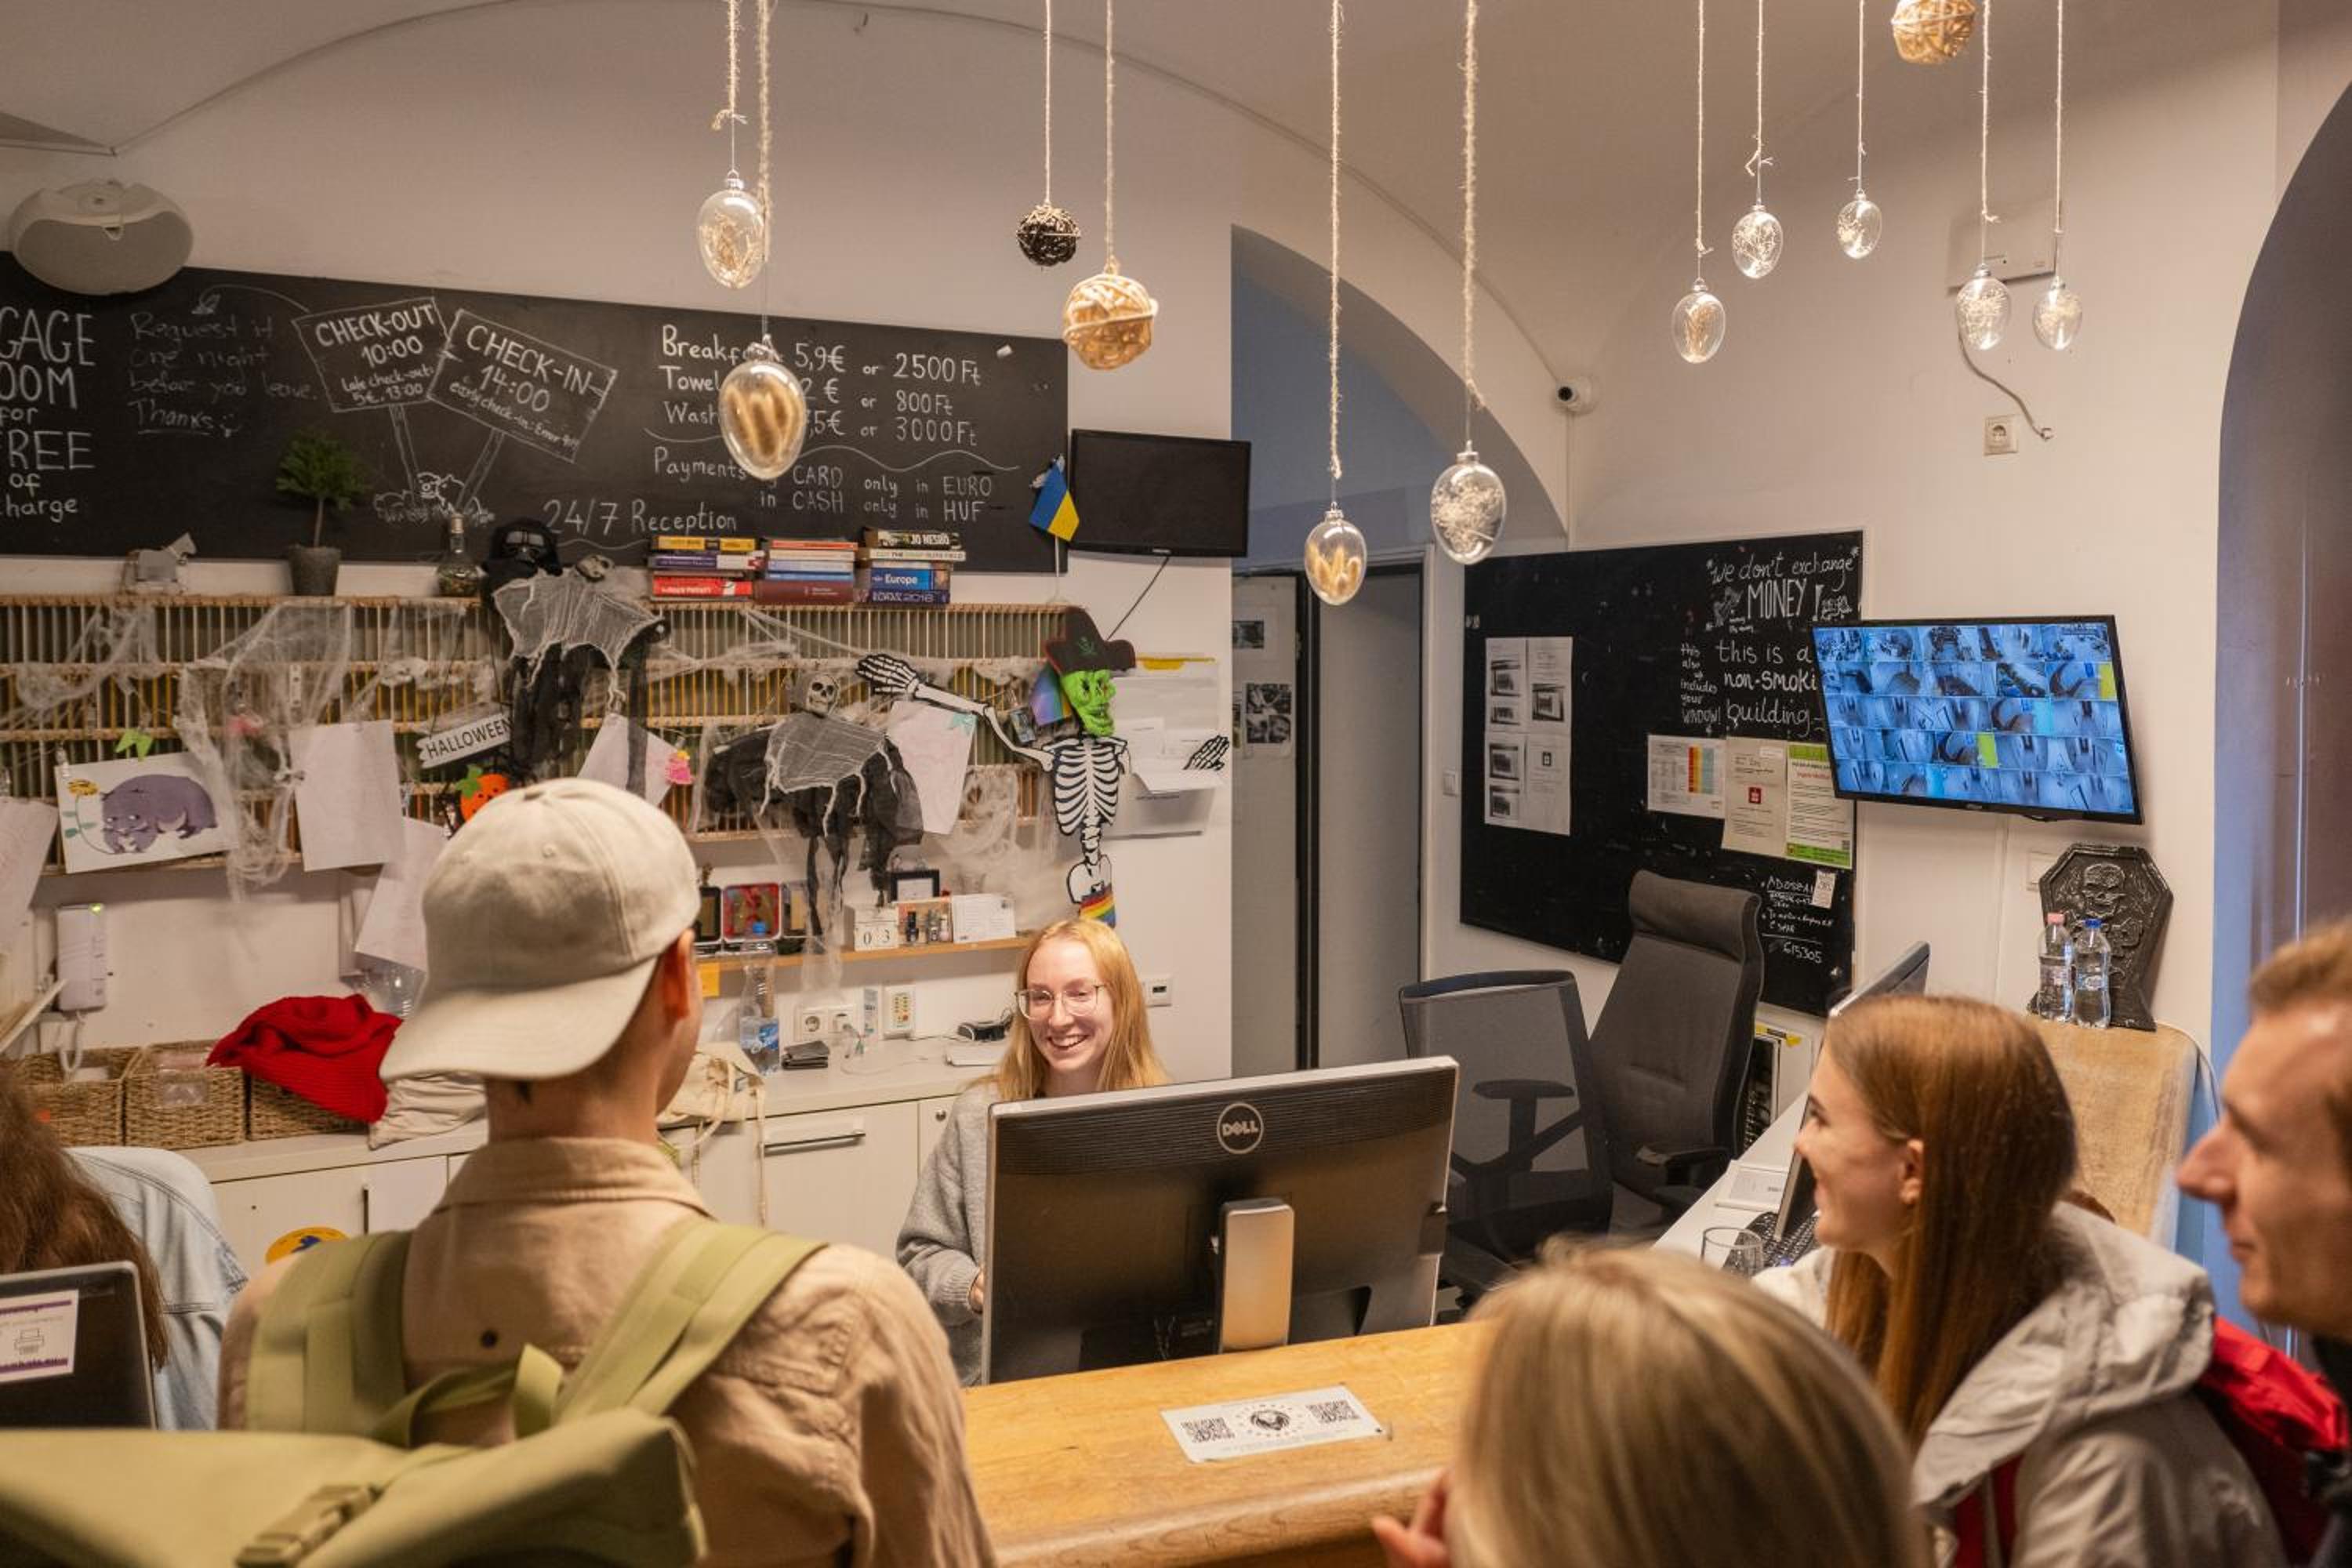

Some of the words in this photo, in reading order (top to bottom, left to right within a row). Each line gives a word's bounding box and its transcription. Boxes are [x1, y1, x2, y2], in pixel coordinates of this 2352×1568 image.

[316, 304, 434, 347] CHECK-OUT
[362, 336, 423, 368] 10:00
[467, 325, 593, 394] CHECK-IN
[794, 343, 846, 373] 5,9€
[862, 365, 880, 376] or
[480, 365, 550, 412] 14:00
[861, 397, 877, 409] or
[860, 426, 878, 437] or
[0, 429, 96, 470] REE
[654, 446, 747, 483] Payments
[9, 473, 41, 498] of
[793, 464, 844, 488] CARD
[864, 474, 898, 499] only
[916, 479, 929, 493] in
[942, 475, 993, 496] EURO
[0, 493, 78, 523] harge
[543, 499, 619, 536] 24/7
[631, 499, 737, 535] Reception
[760, 490, 777, 507] in
[793, 490, 844, 513] CASH
[863, 496, 898, 519] only
[916, 503, 929, 519] in
[943, 500, 985, 521] HUF
[884, 573, 918, 586] Europe
[1738, 552, 1784, 580] don't
[1747, 578, 1808, 619] MONEY
[1715, 639, 1758, 665] this
[1766, 643, 1784, 665] is
[1795, 646, 1813, 664] a
[426, 717, 512, 759] HALLOWEEN
[1221, 1120, 1259, 1138] DELL
